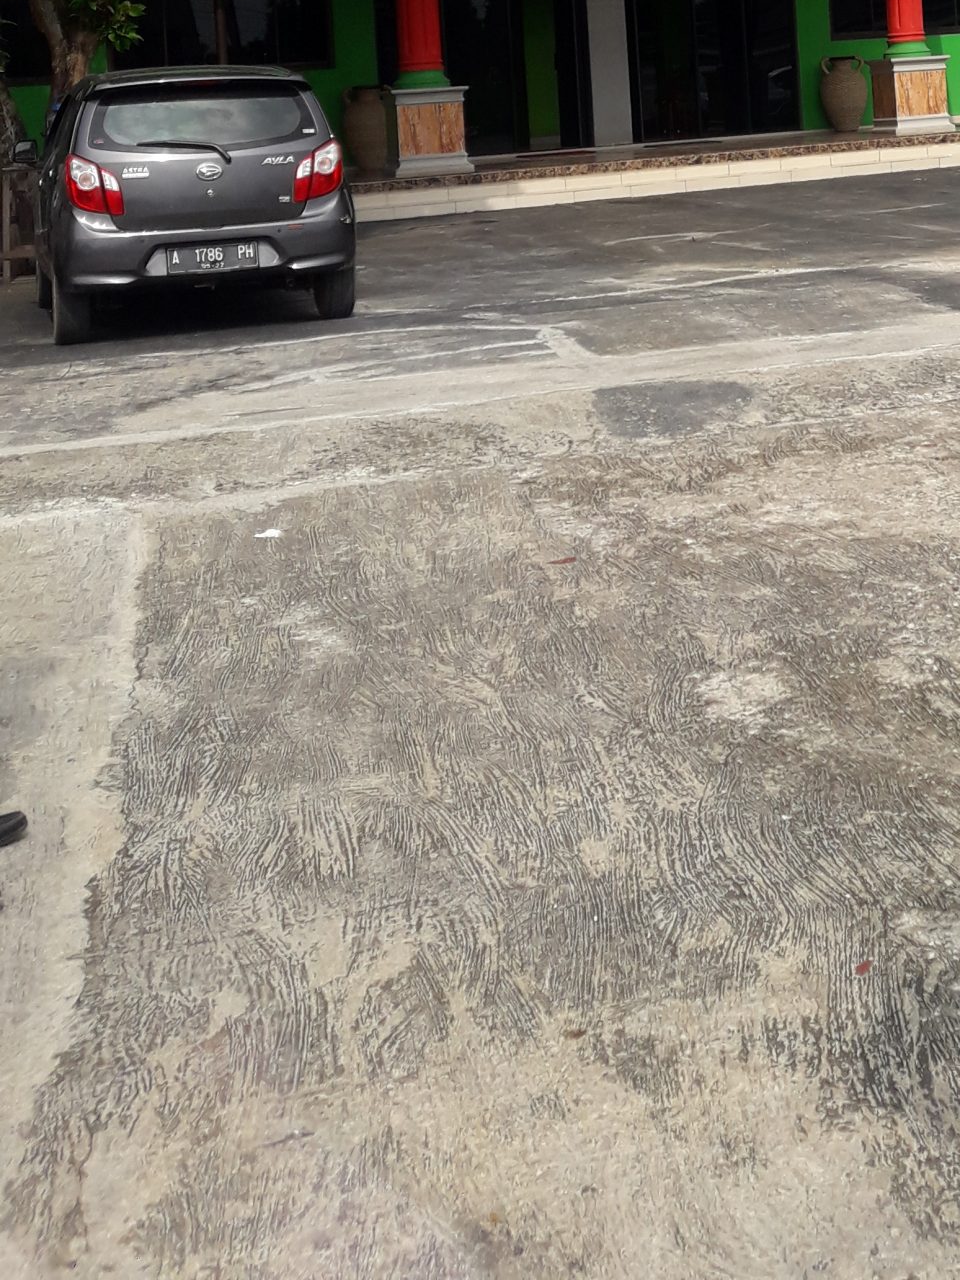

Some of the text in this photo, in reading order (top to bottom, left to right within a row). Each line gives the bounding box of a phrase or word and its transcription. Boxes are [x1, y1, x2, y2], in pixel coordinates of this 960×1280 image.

[261, 155, 295, 165] AYLA
[172, 243, 254, 265] A 1786 PH
